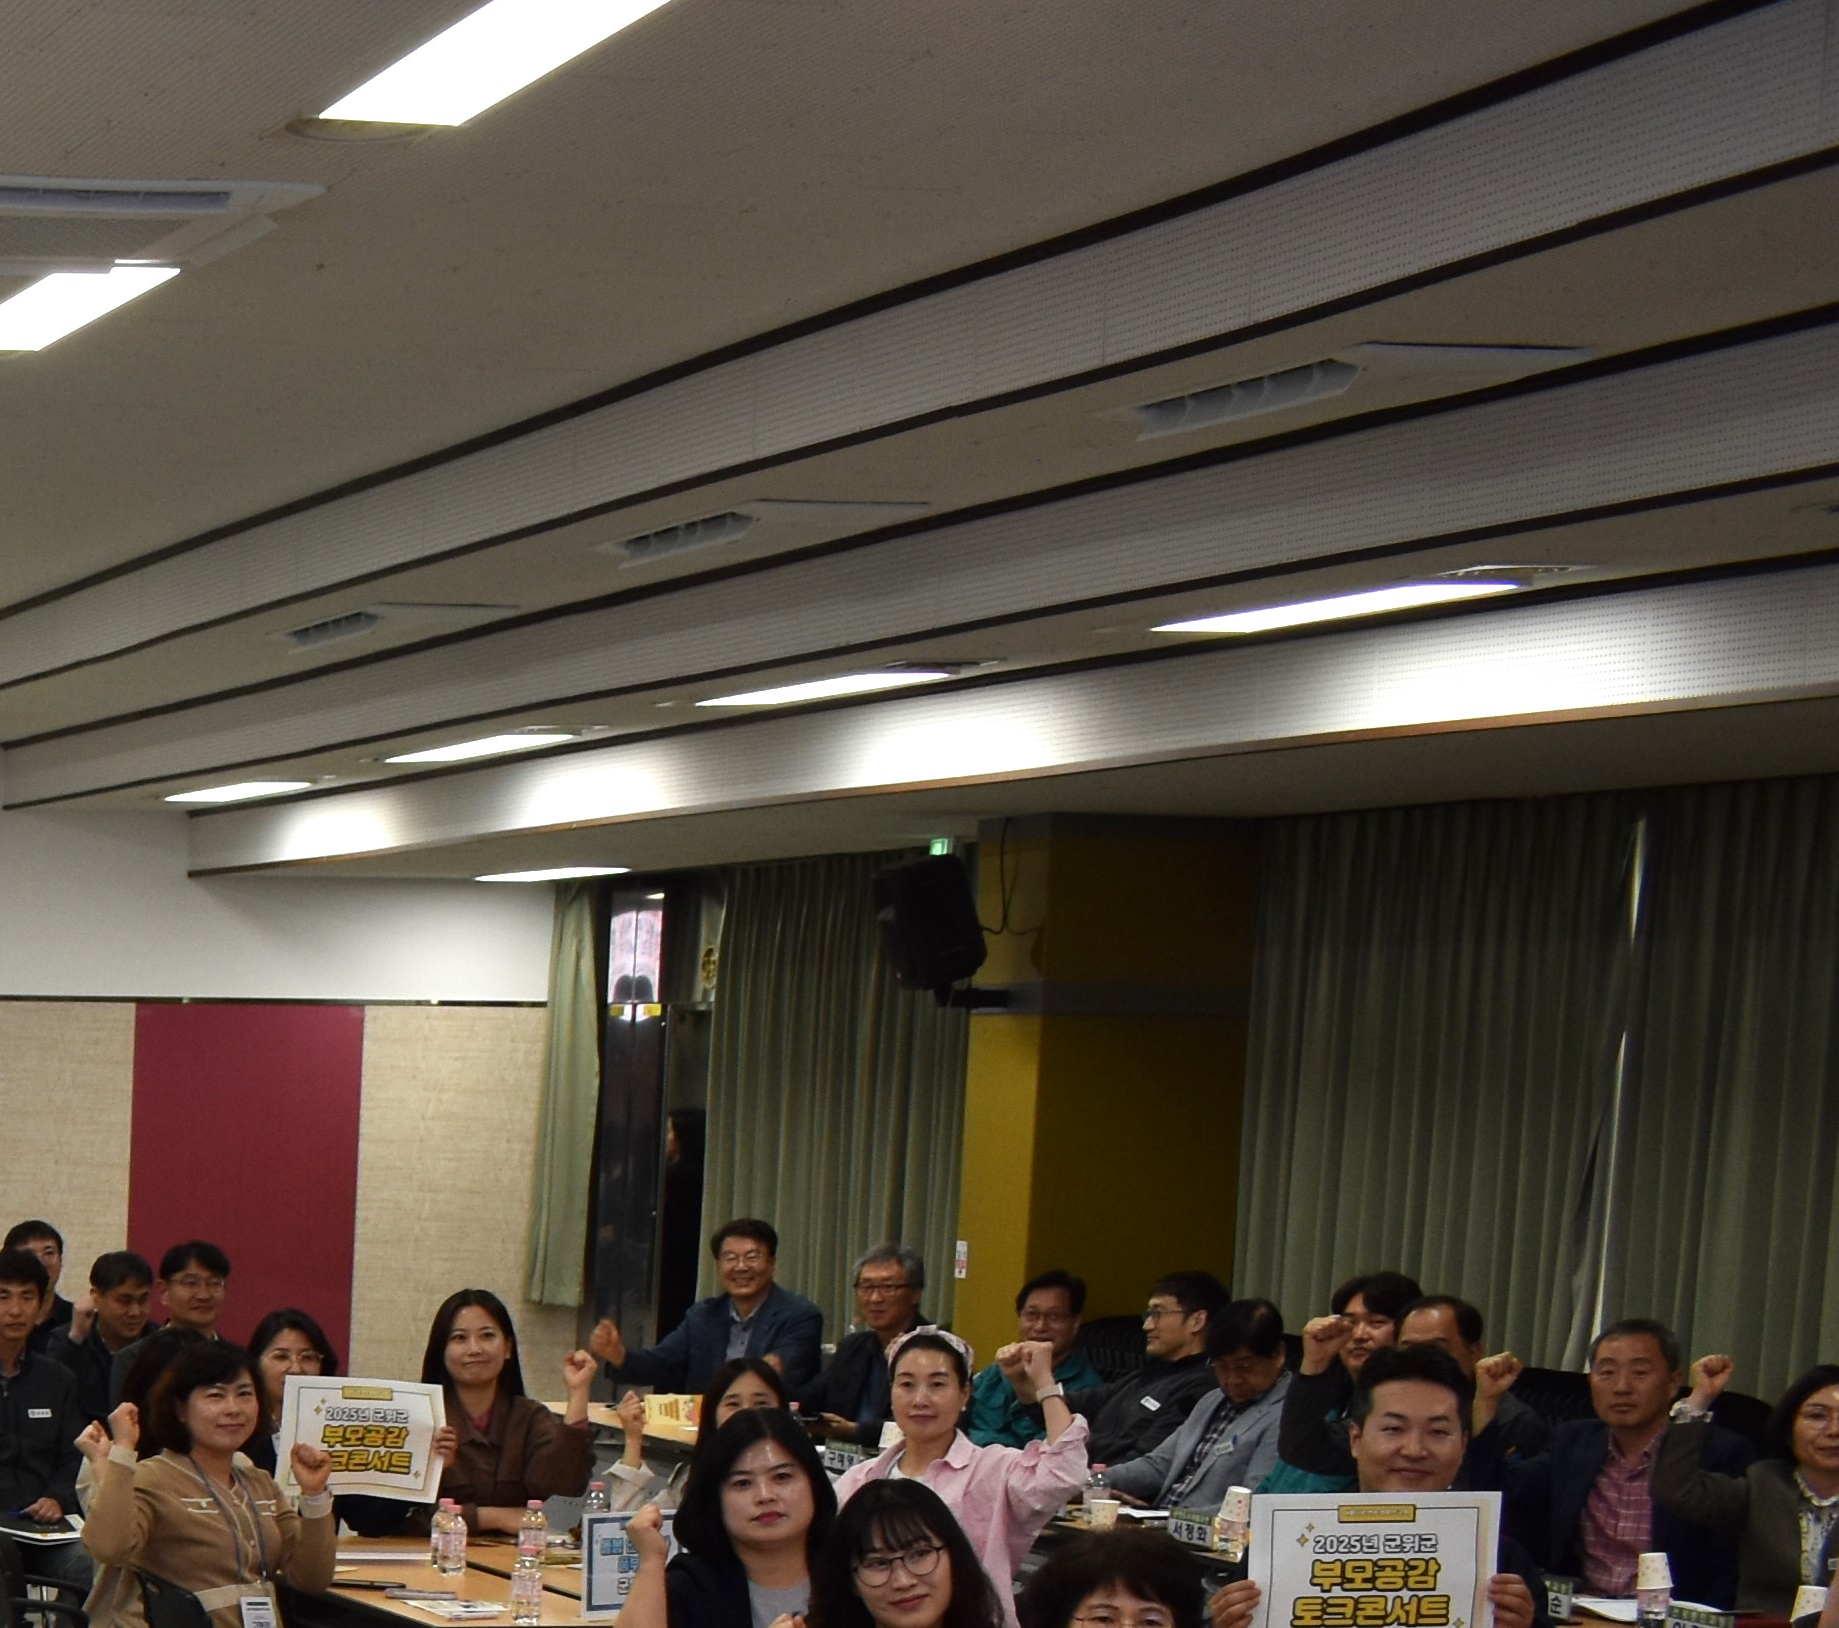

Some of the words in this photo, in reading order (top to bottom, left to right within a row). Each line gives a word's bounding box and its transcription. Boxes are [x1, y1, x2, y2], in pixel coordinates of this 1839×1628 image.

[325, 1407, 370, 1422] 2025년
[372, 1407, 409, 1423] 군위군
[321, 1424, 409, 1448] 부모공감
[328, 1450, 412, 1475] 크콘서트
[1313, 1534, 1379, 1554] 2025년
[1383, 1533, 1438, 1553] 군위군
[1309, 1557, 1442, 1593] 부모공감
[1290, 1594, 1450, 1628] 토크콘서트
